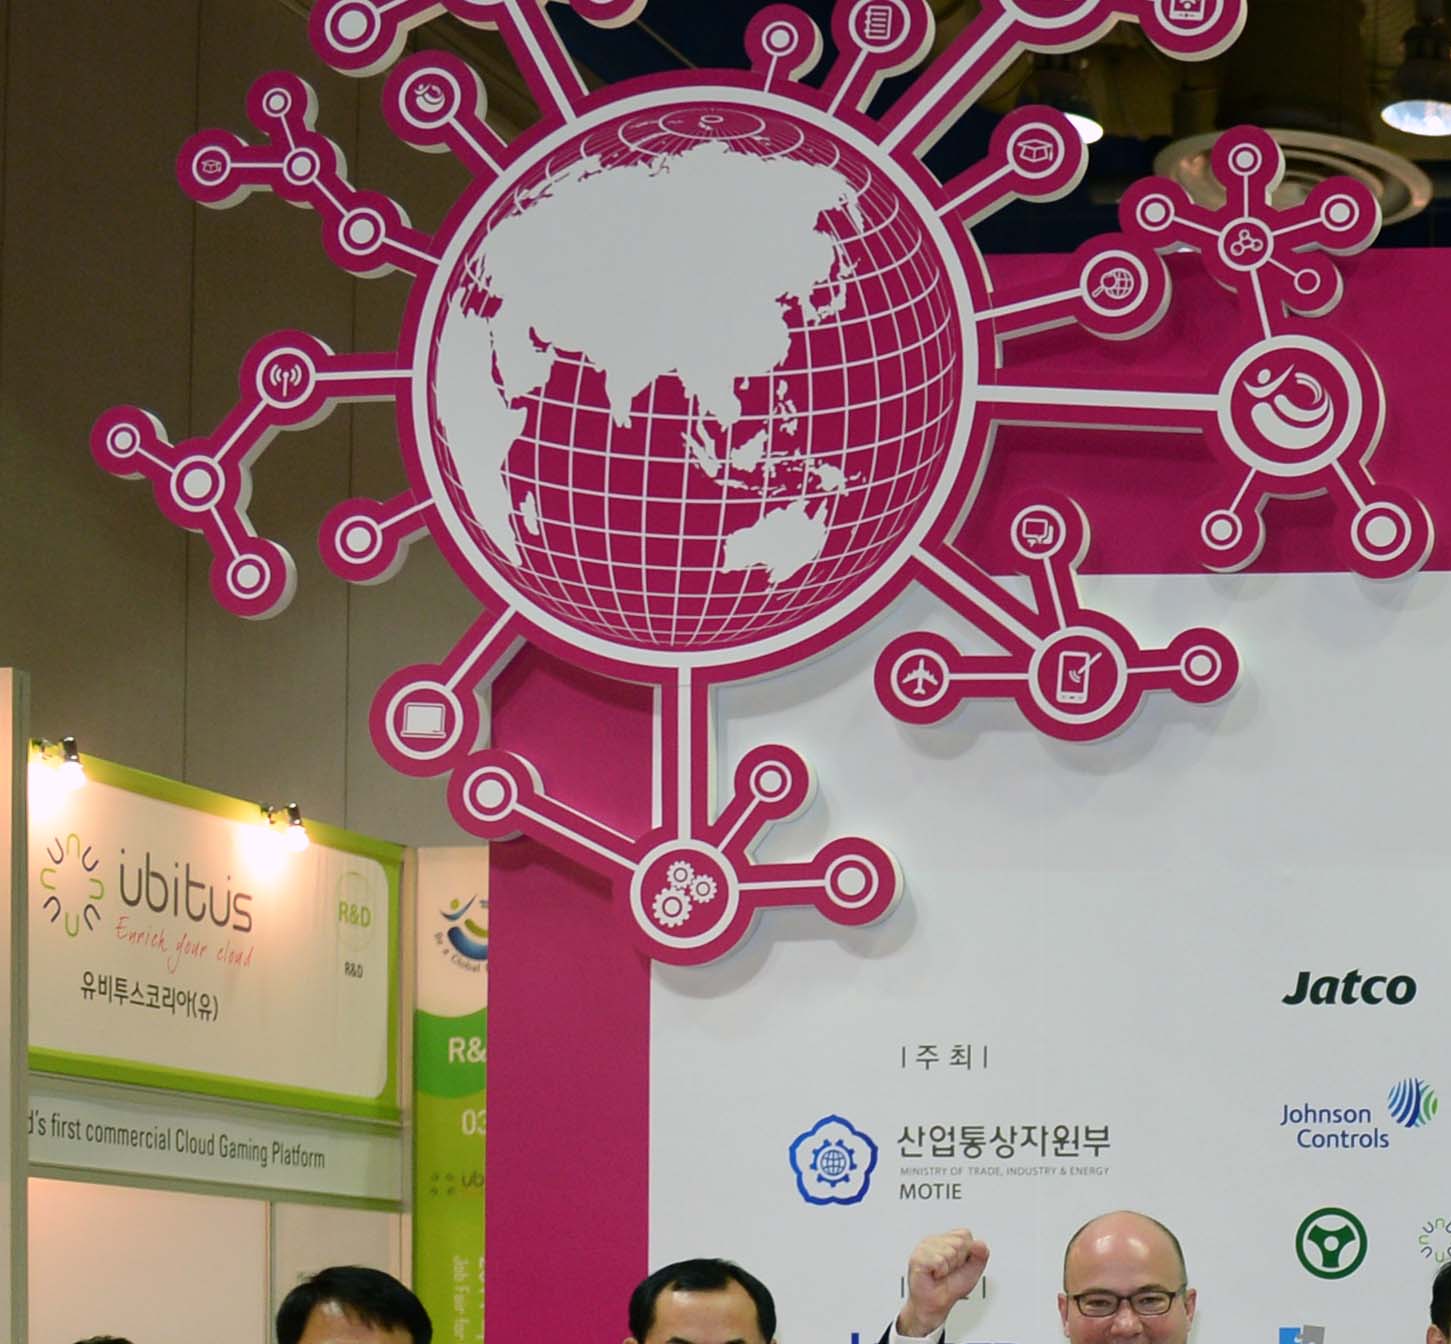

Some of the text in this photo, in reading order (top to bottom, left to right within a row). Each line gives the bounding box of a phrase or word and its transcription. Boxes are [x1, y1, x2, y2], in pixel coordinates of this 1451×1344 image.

[338, 901, 372, 928] R&D
[344, 961, 364, 979] R&D
[80, 970, 219, 1022] 유비투스코리아(유)
[1281, 969, 1417, 1006] Jatco
[1279, 1103, 1372, 1127] Johnson
[50, 1112, 325, 1169] first commercial Cloud Gaming Platform
[897, 1124, 1111, 1160] 산업통상자원부
[1296, 1127, 1390, 1149] Controls
[900, 1166, 948, 1176] MINISTRY
[949, 1166, 963, 1176] OF
[1006, 1166, 1057, 1177] INDUSTRY
[899, 1183, 962, 1200] MOTIE
